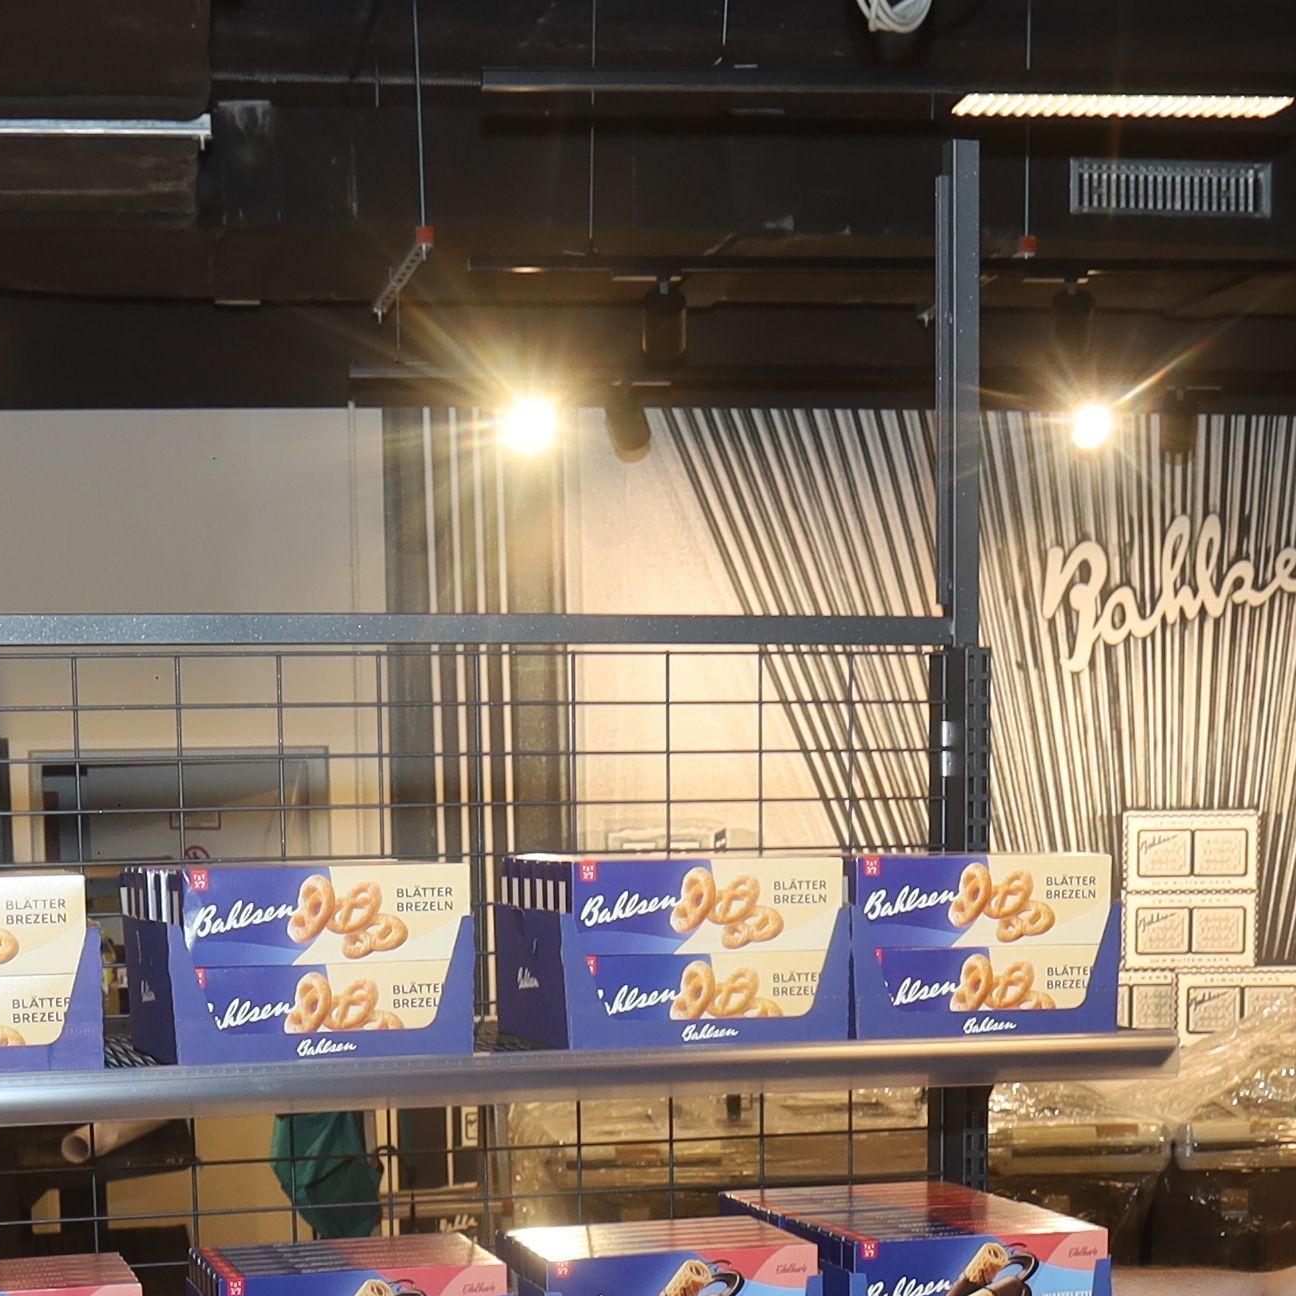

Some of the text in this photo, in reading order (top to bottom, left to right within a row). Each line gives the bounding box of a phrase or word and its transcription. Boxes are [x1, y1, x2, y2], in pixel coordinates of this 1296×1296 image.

[773, 880, 826, 891] BLÄTTER
[1046, 876, 1096, 886] BLÄTTER
[397, 886, 453, 898] BLÄTTER
[1046, 889, 1096, 899] BREZELN
[6, 898, 66, 911] BLÄTTER
[773, 894, 827, 904] BREZELN
[864, 885, 959, 920] Bahlsen
[397, 901, 453, 912] BREZELN
[581, 891, 681, 927] Bahlsen
[6, 913, 67, 925] BREZELN
[193, 900, 299, 937] Bahlsen
[1047, 966, 1092, 976] BLÄTTE
[772, 972, 821, 983] BLÄTTE
[393, 982, 444, 995] BLÄTTE
[13, 1012, 66, 1023] BREZEL
[963, 1017, 1016, 1034] Bahlsen
[681, 1024, 739, 1042] Bahlsen
[297, 1039, 356, 1057] Bahlsen
